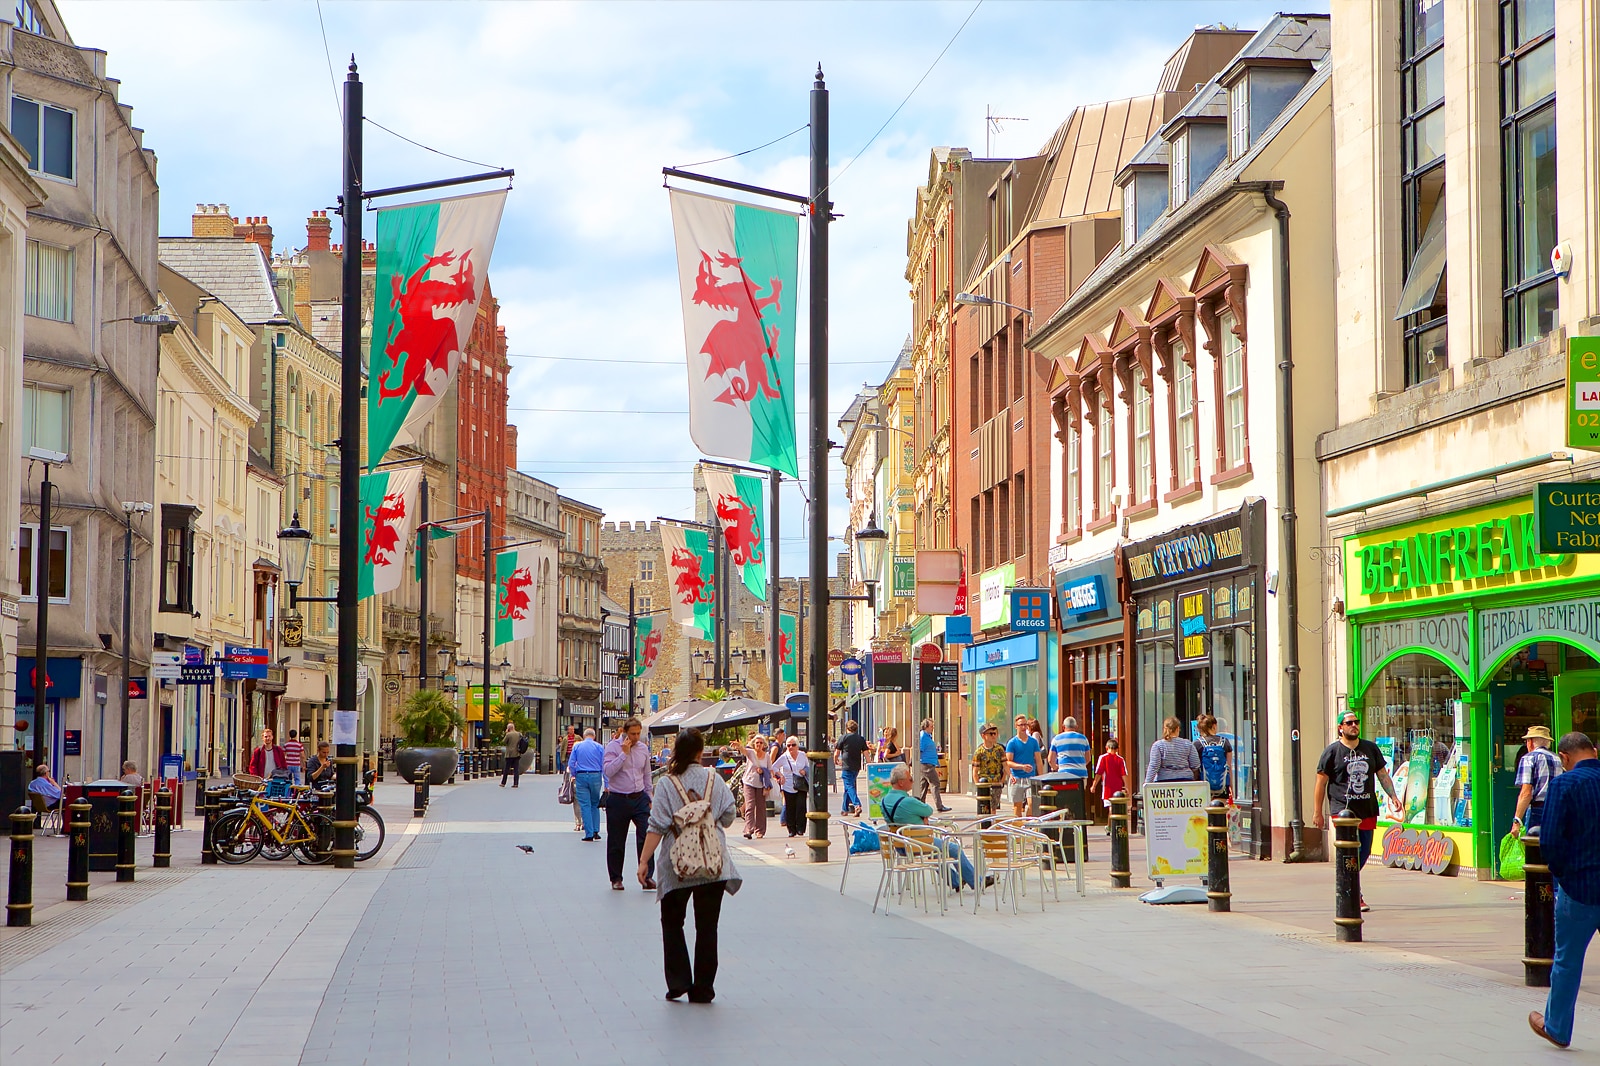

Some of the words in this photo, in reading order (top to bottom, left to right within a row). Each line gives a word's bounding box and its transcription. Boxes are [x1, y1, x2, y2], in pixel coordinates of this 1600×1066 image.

[1577, 413, 1599, 427] 02
[1155, 532, 1212, 578] TATTOO
[1070, 582, 1097, 609] GREGGS
[1015, 619, 1045, 627] GREGGS
[1481, 608, 1533, 661] HERBAL
[1364, 622, 1413, 671] HEALTH
[1419, 615, 1469, 666] FOODS
[1151, 788, 1183, 799] WHAT'S
[1151, 799, 1175, 809] YOUR
[1176, 798, 1203, 809] JUICE?
[1424, 837, 1448, 867] RAW
